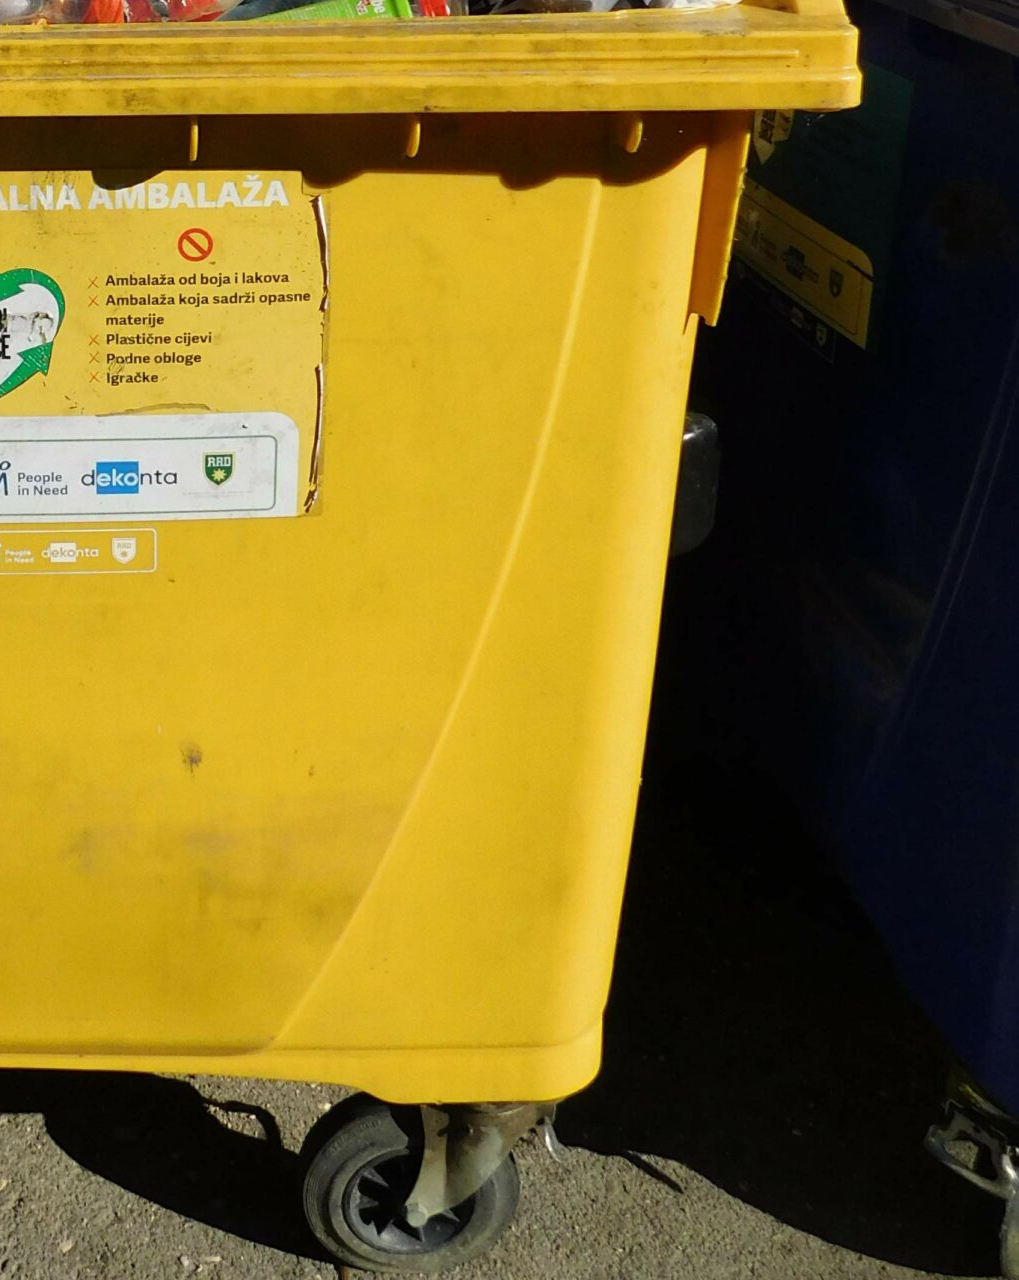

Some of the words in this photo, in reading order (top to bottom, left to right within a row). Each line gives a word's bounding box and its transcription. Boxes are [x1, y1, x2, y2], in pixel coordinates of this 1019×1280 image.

[88, 175, 289, 210] AMBALAŽA
[105, 273, 176, 287] Ambalaža
[178, 273, 197, 286] od
[200, 272, 231, 289] boja
[234, 272, 238, 285] i
[241, 271, 289, 285] lakova
[105, 293, 176, 307] Ambalaža
[178, 293, 209, 308] koja
[212, 291, 255, 305] sadrži
[258, 293, 311, 307] opasne
[105, 313, 165, 328] materije
[106, 332, 171, 346] Plastične
[174, 331, 213, 347] cijevi
[106, 352, 150, 365] Podne
[154, 351, 202, 367] obloge
[106, 371, 159, 386] Igračke
[207, 457, 231, 467] RAD
[17, 472, 63, 486] People
[80, 468, 178, 487] dekonta
[17, 484, 30, 496] in
[33, 484, 68, 496] Need
[41, 544, 99, 558] dekonta
